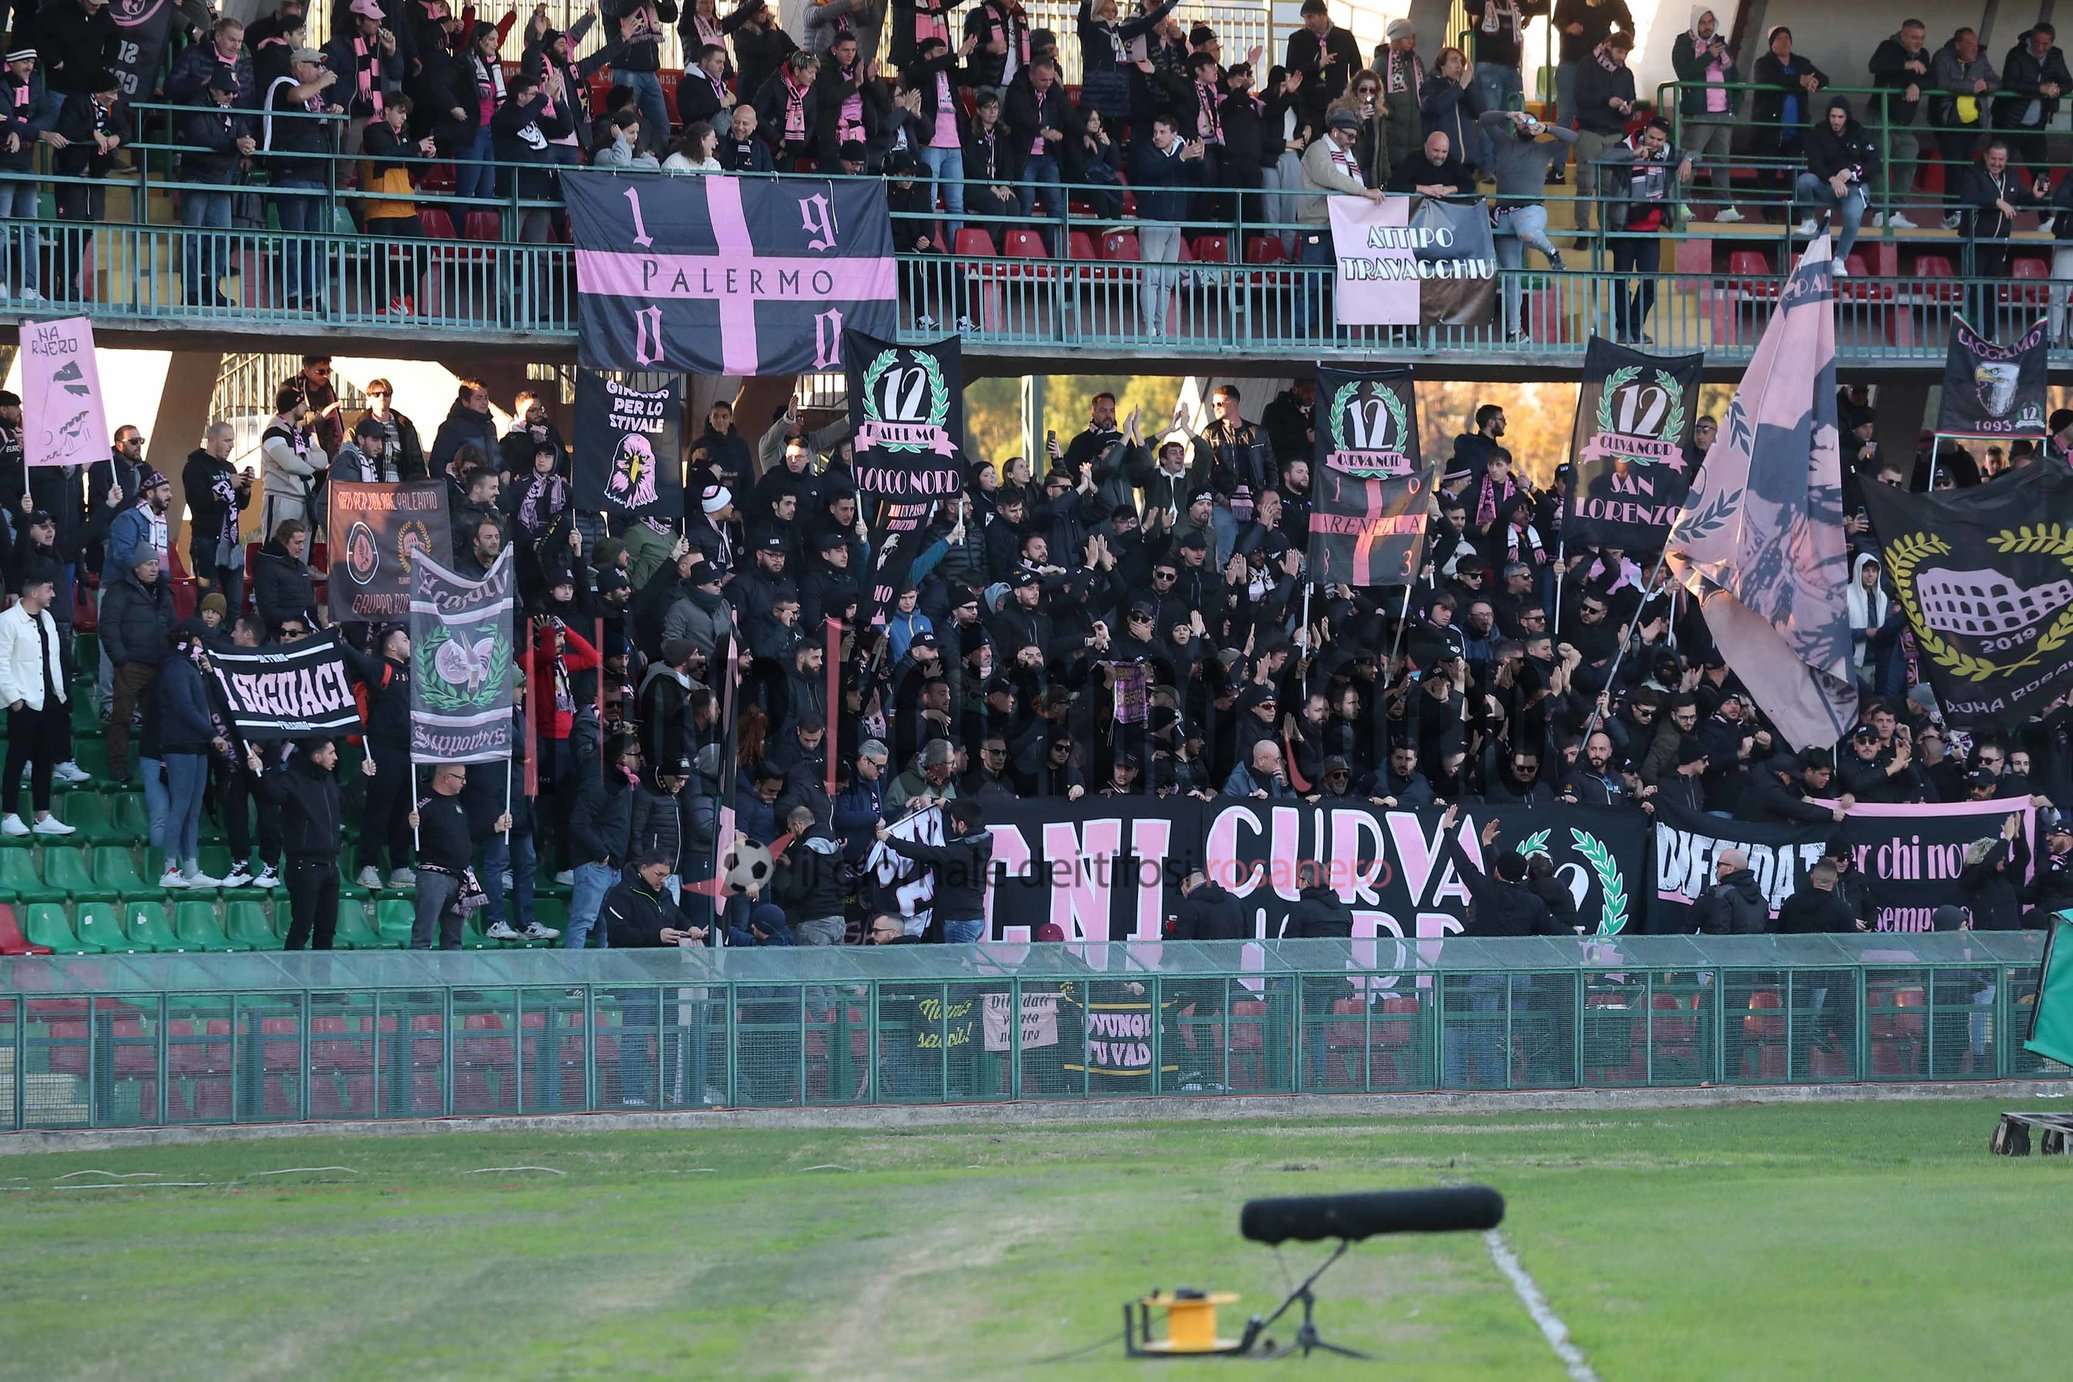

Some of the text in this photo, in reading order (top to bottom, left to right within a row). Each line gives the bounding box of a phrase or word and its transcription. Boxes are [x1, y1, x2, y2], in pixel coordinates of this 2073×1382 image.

[1367, 225, 1454, 249] ATTIPO
[642, 259, 834, 295] PALERMO
[613, 397, 664, 416] PER LO
[884, 366, 927, 422] 12
[609, 413, 665, 434] STIVALE
[1347, 398, 1393, 450] 12
[1620, 384, 1668, 438] 12
[1600, 434, 1673, 457] CURVA NORD
[1337, 452, 1374, 467] CURVA
[910, 468, 960, 495] NORD
[1609, 472, 1655, 497] SAN
[397, 491, 438, 511] PALERMO
[1575, 496, 1682, 527] LORENZO
[351, 593, 393, 615] GRUPPO
[1980, 627, 2037, 653] 2019
[231, 659, 357, 718] SEGUACI
[1205, 805, 1487, 907] CURVA
[1876, 834, 1921, 880] chi
